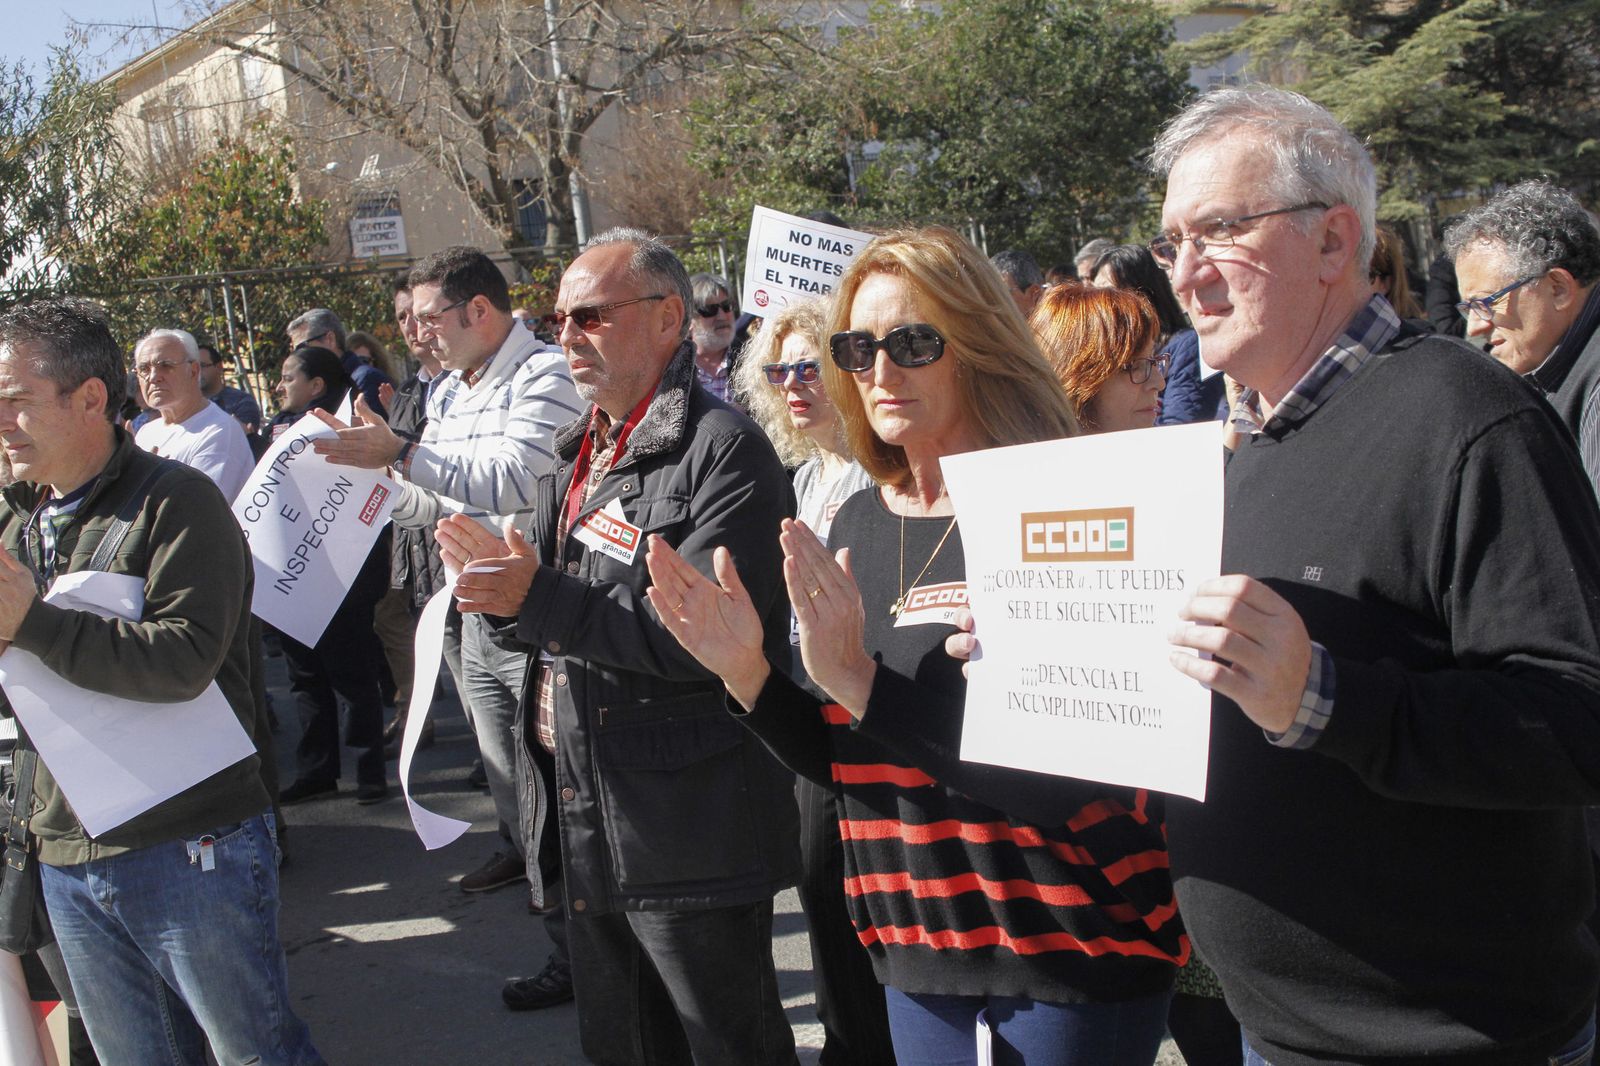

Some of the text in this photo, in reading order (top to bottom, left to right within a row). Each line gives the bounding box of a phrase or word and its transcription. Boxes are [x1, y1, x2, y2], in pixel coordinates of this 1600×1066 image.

[789, 230, 854, 257] NO MAS
[766, 246, 844, 277] MUERTES
[765, 268, 783, 285] EL
[243, 433, 318, 524] CONTROL
[280, 504, 301, 524] E
[273, 475, 354, 595] INSPECCIÓN
[1025, 518, 1128, 554] CCOO
[601, 541, 632, 560] granada
[1096, 569, 1116, 590] TU
[1121, 568, 1185, 591] PUEDES
[1007, 600, 1155, 625] SER EL SIGUIENTE!!!
[1123, 671, 1144, 693] EL
[1007, 691, 1162, 729] INCUMPLIMIENTO!!!!
